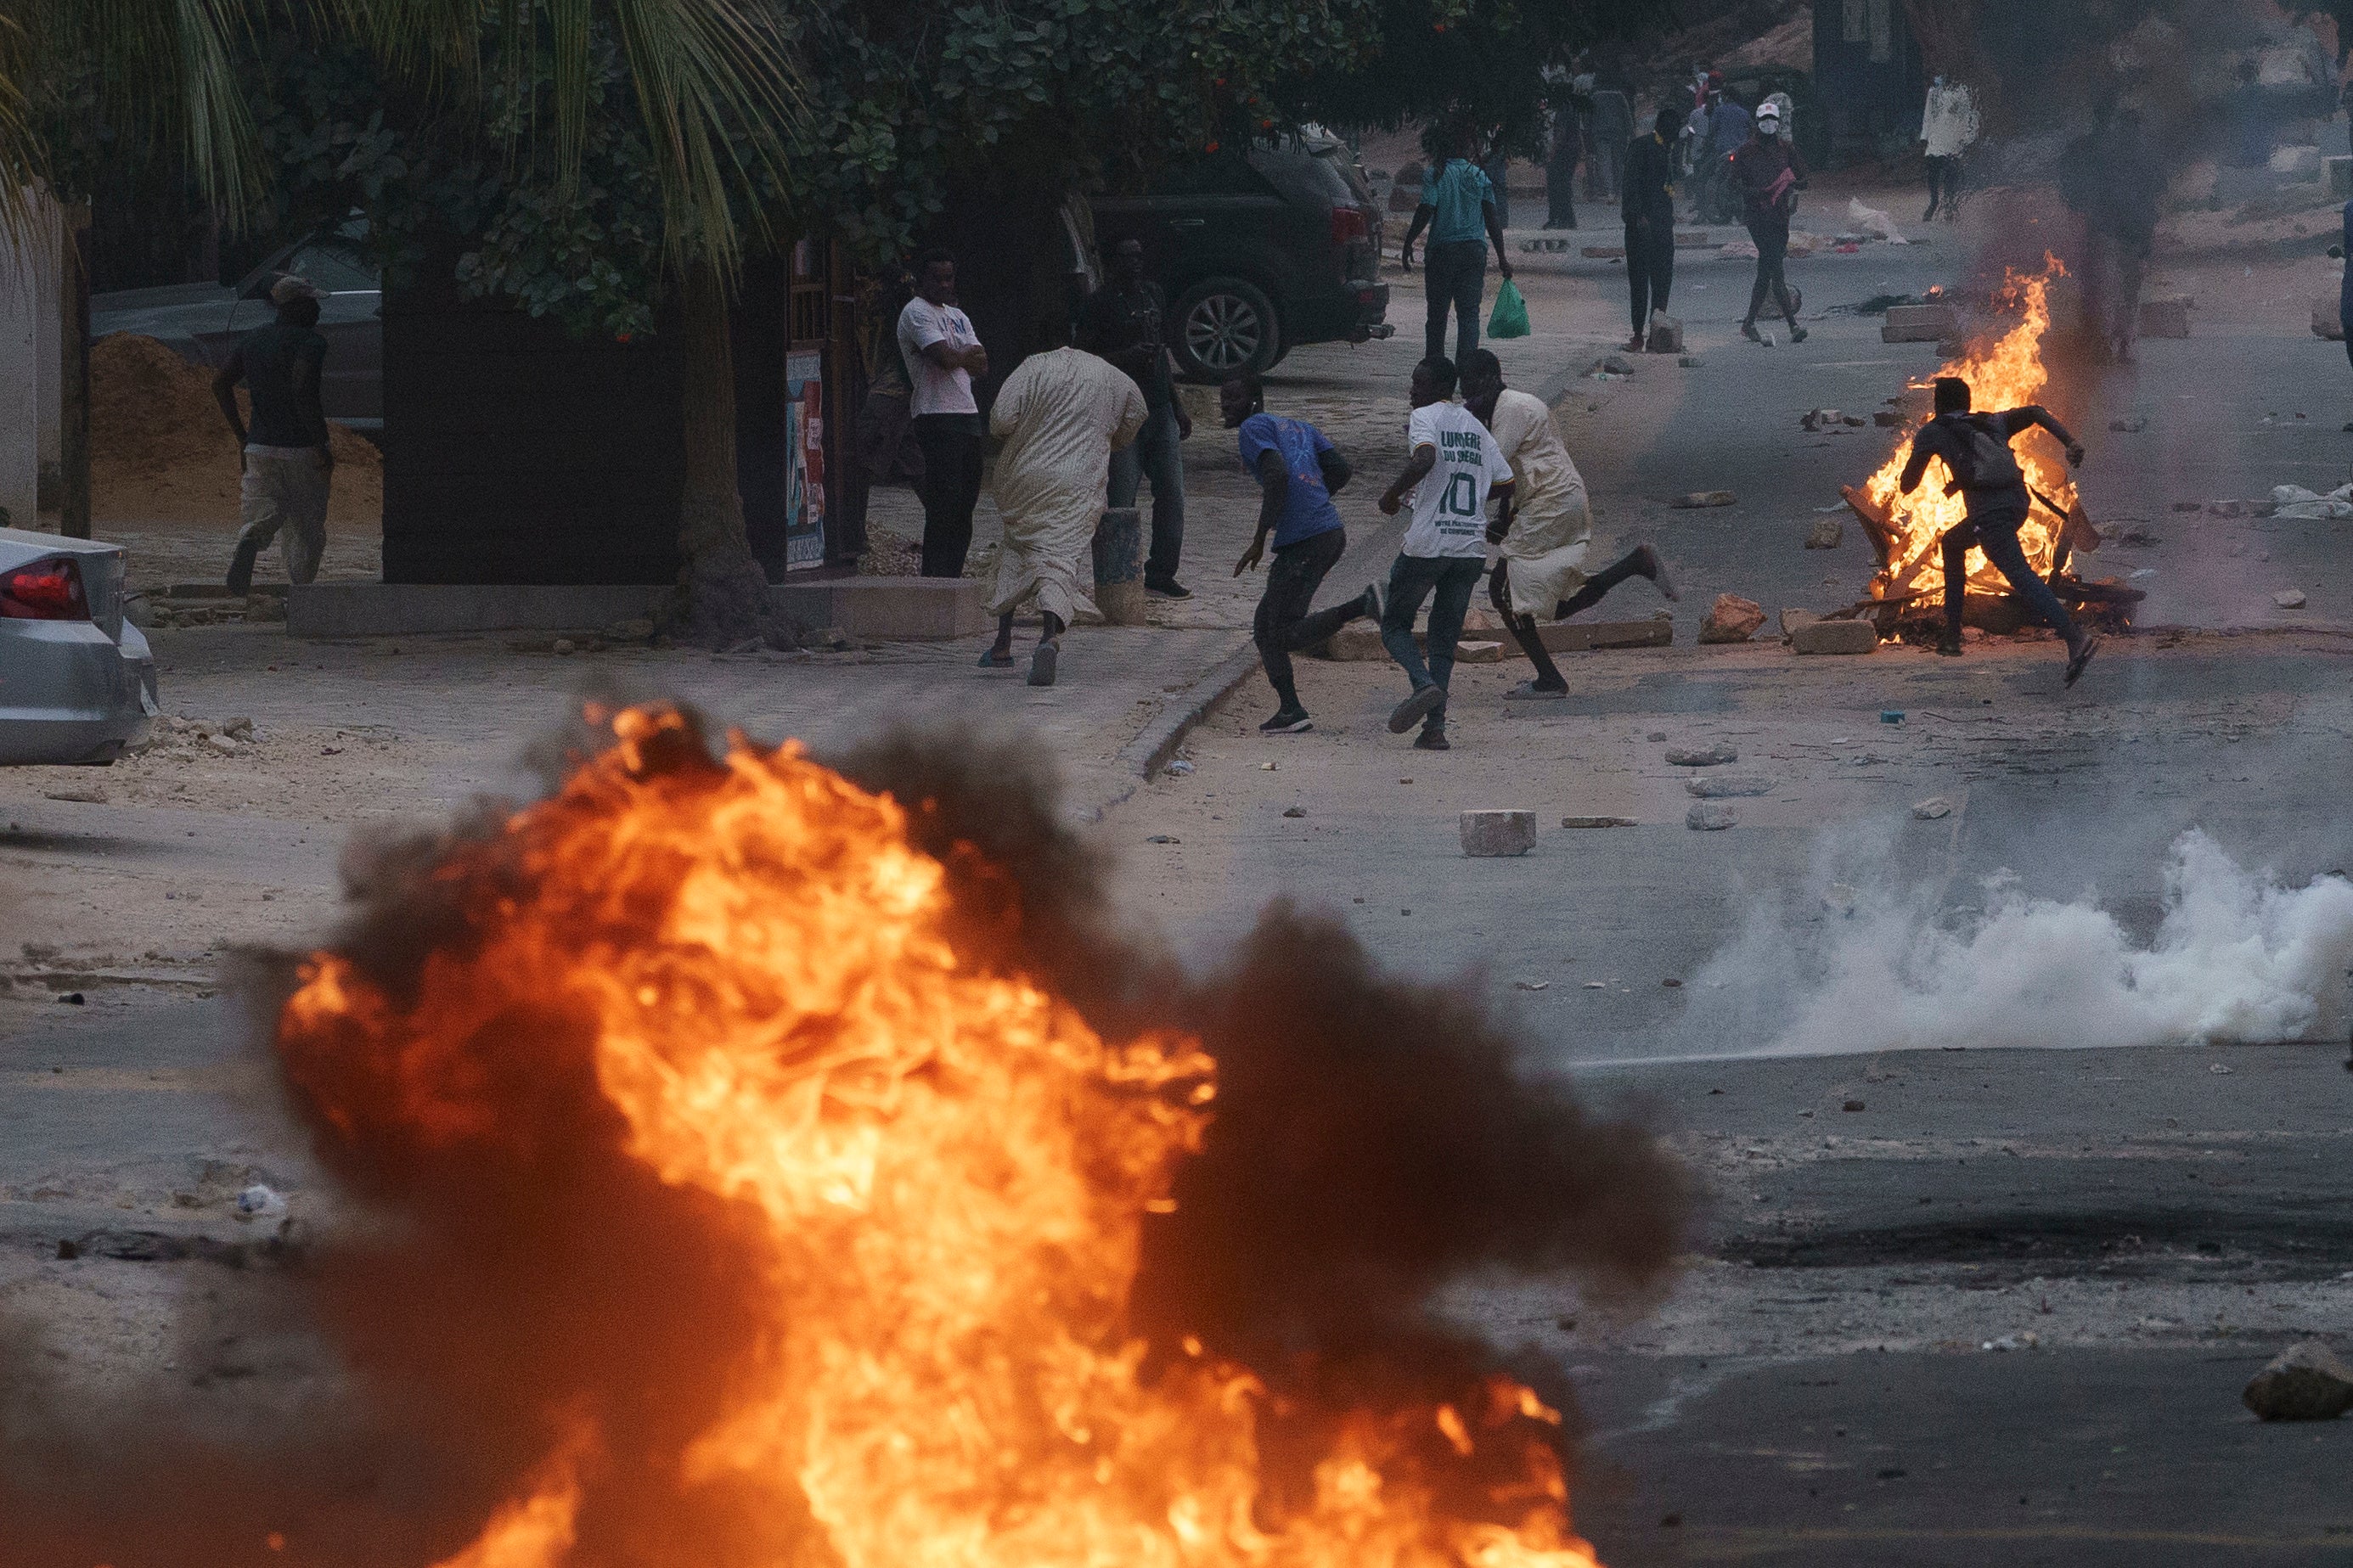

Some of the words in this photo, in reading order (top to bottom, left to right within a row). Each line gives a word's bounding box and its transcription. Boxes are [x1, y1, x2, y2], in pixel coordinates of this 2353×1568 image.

[1444, 450, 1455, 462] DU
[1457, 450, 1483, 466] SEGAL
[1439, 472, 1477, 516] 10
